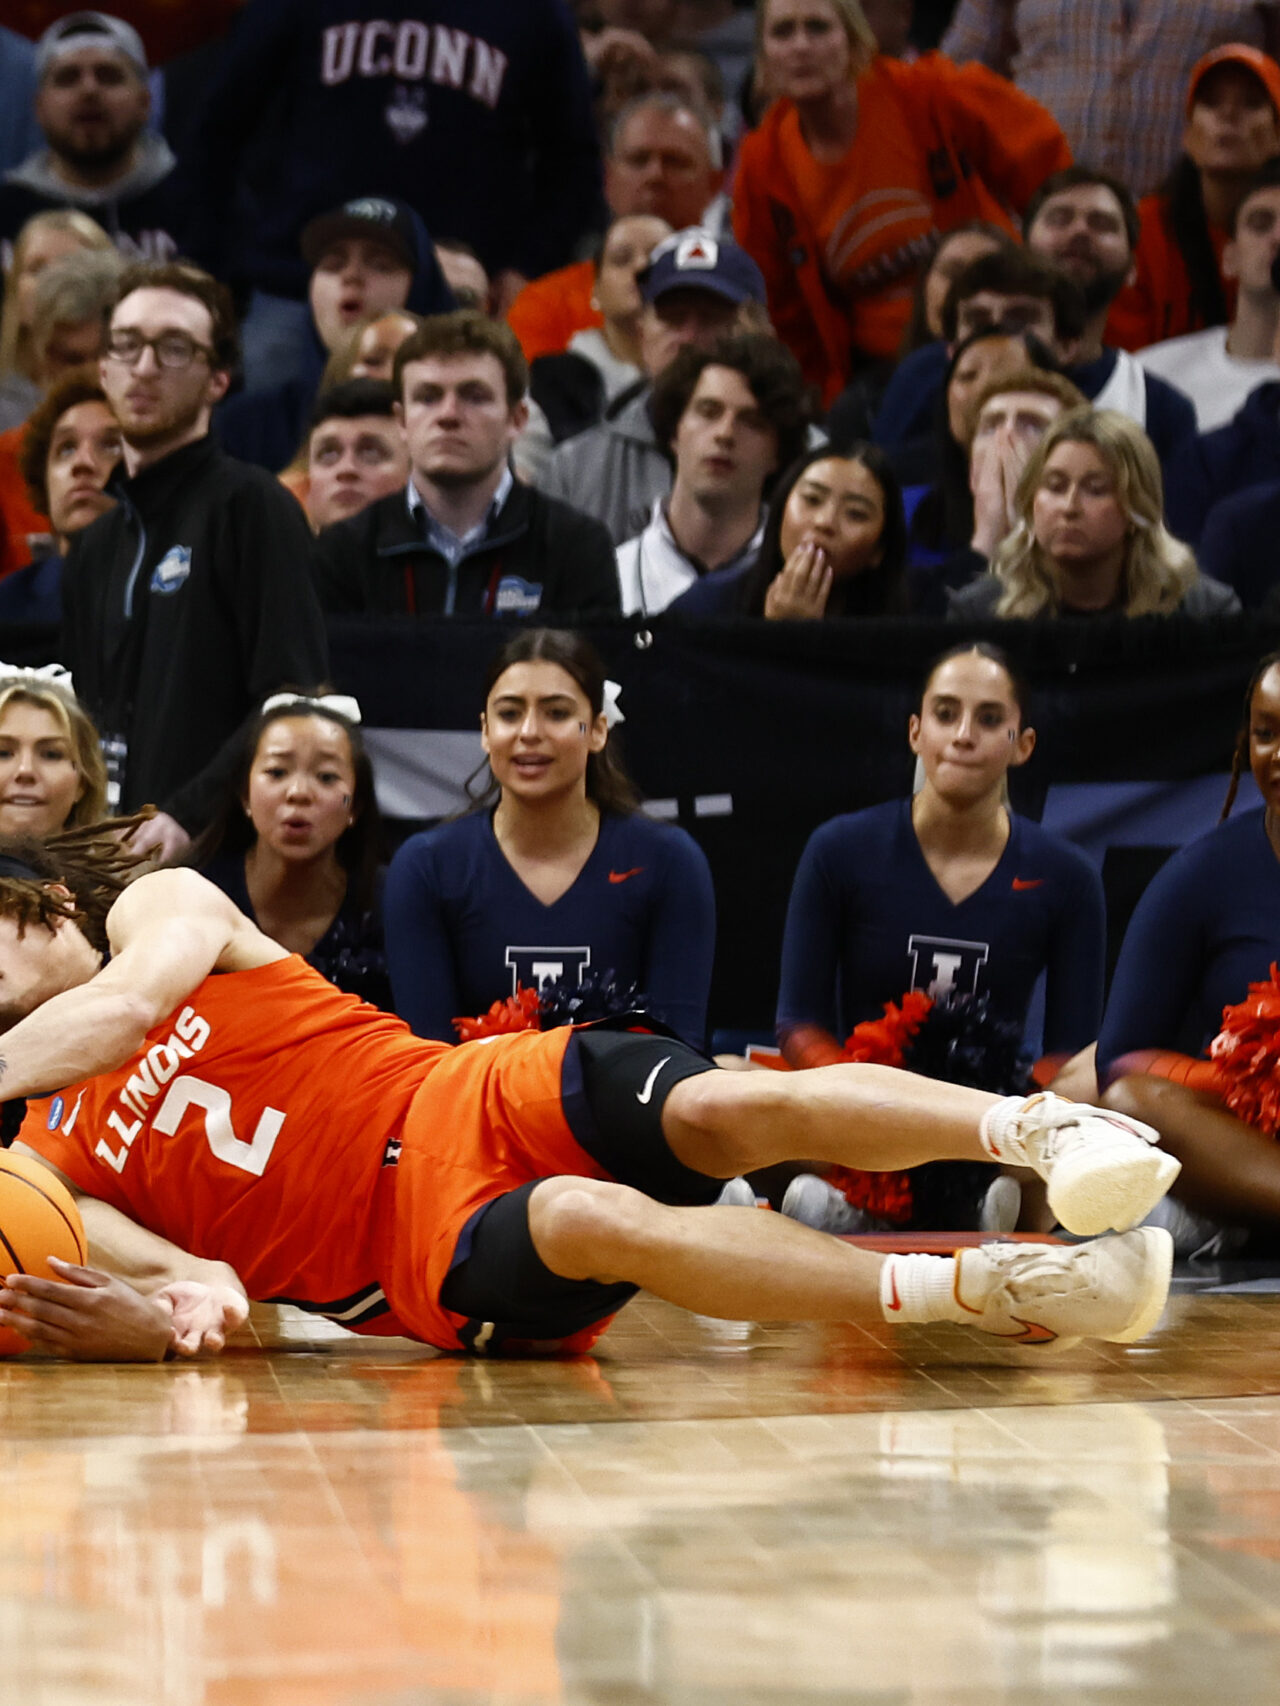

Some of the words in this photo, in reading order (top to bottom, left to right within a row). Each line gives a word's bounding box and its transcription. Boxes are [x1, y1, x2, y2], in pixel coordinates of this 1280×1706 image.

[322, 18, 508, 110] UCONN
[94, 1005, 211, 1174] LLINOIS
[151, 1075, 287, 1177] 2
